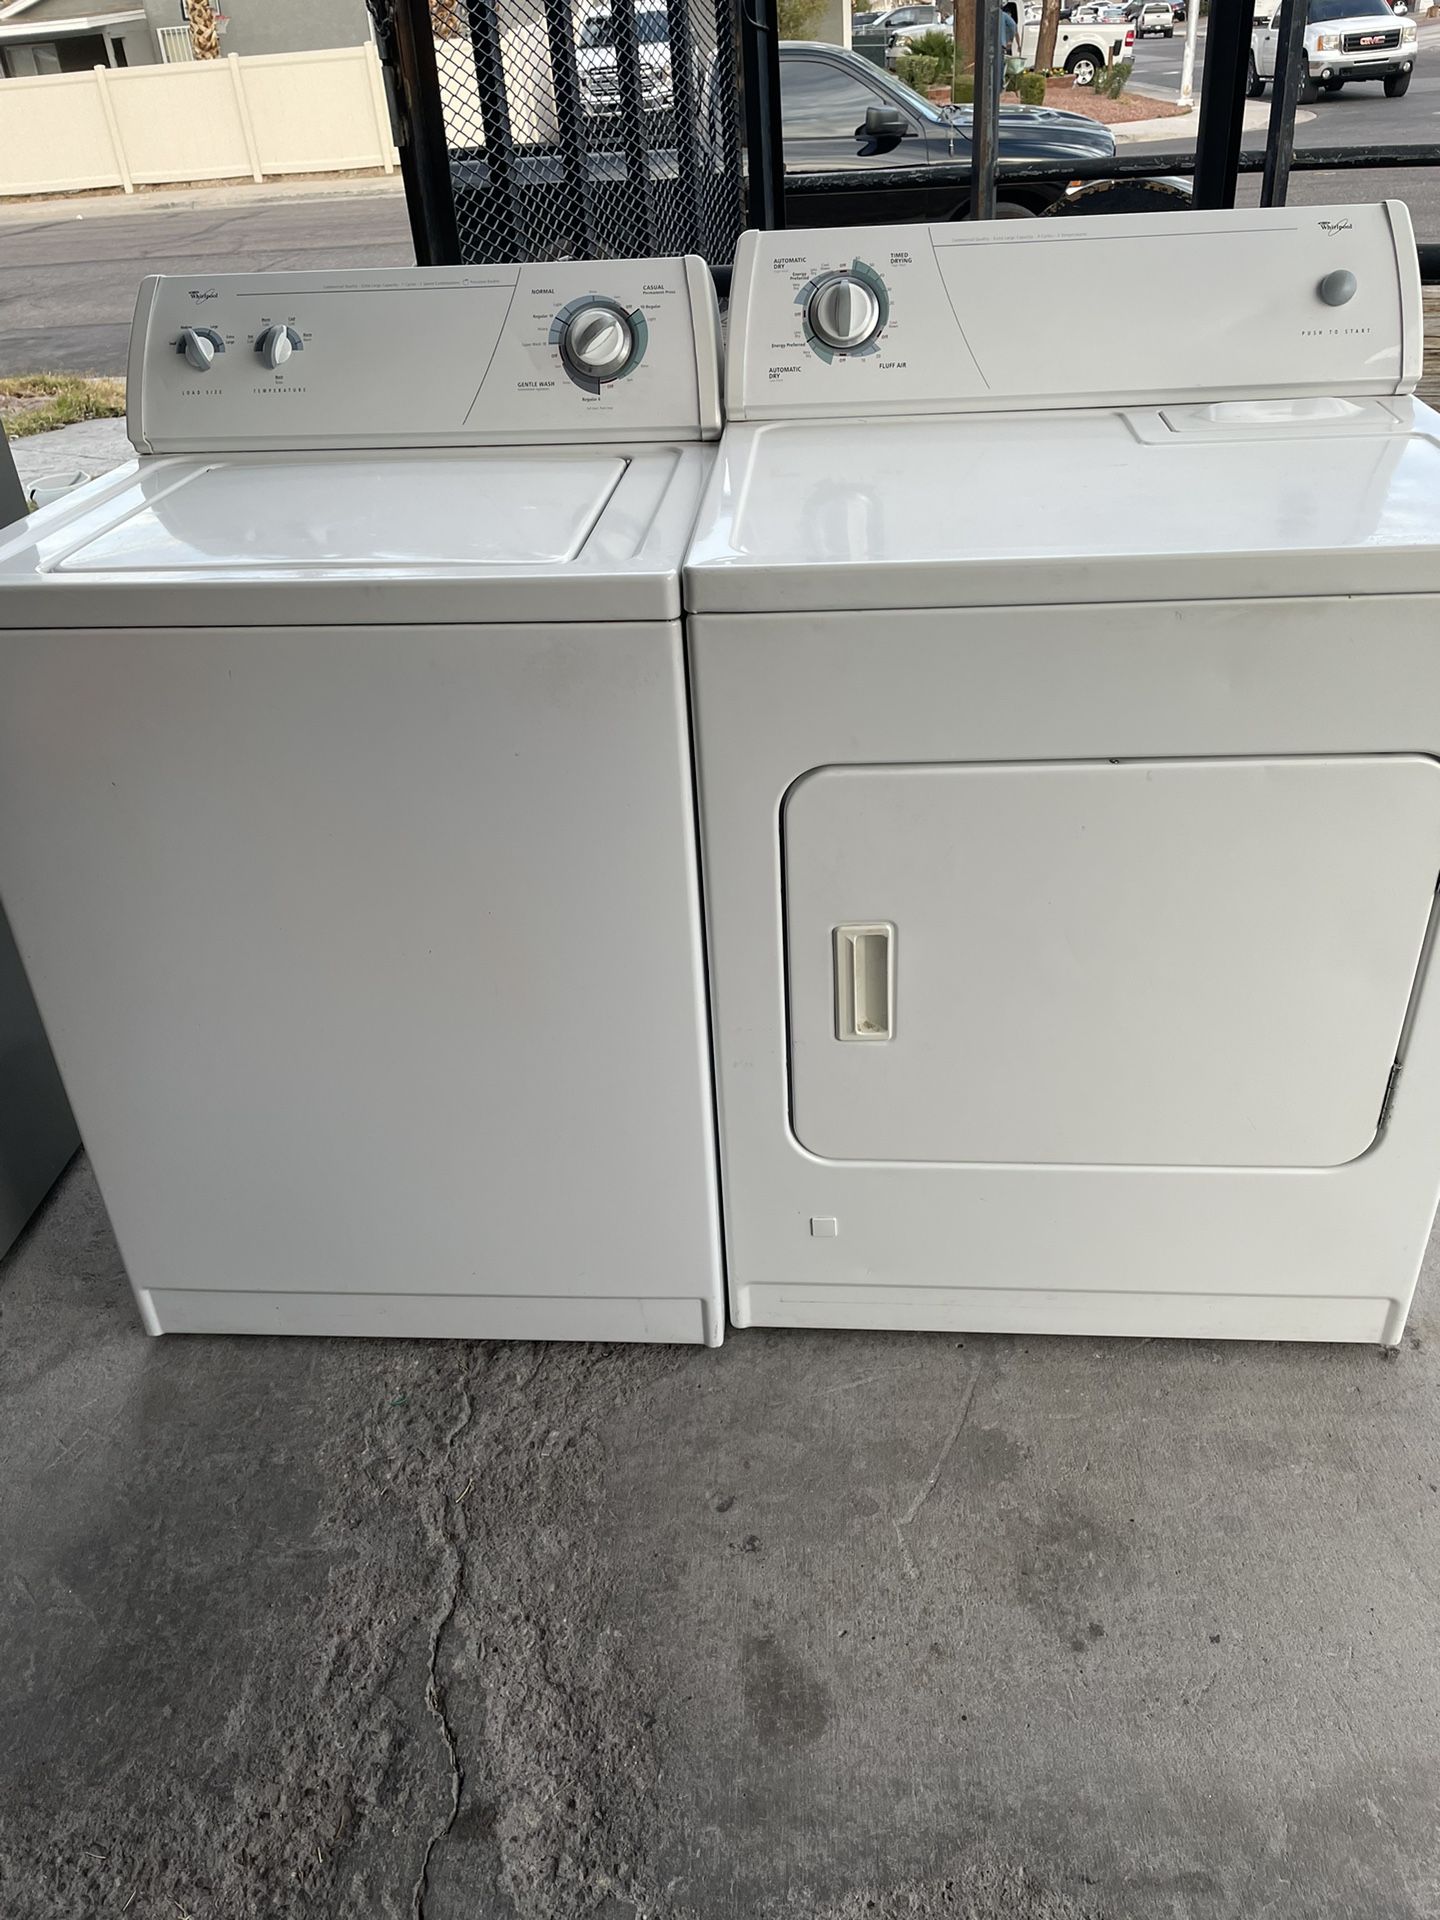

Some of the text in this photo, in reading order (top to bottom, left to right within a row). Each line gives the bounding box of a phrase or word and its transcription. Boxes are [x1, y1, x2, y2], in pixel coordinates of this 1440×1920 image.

[1360, 35, 1386, 46] GMC
[1318, 220, 1352, 234] Whirlpool
[188, 288, 219, 302] Whirlpool
[1344, 327, 1371, 335] START
